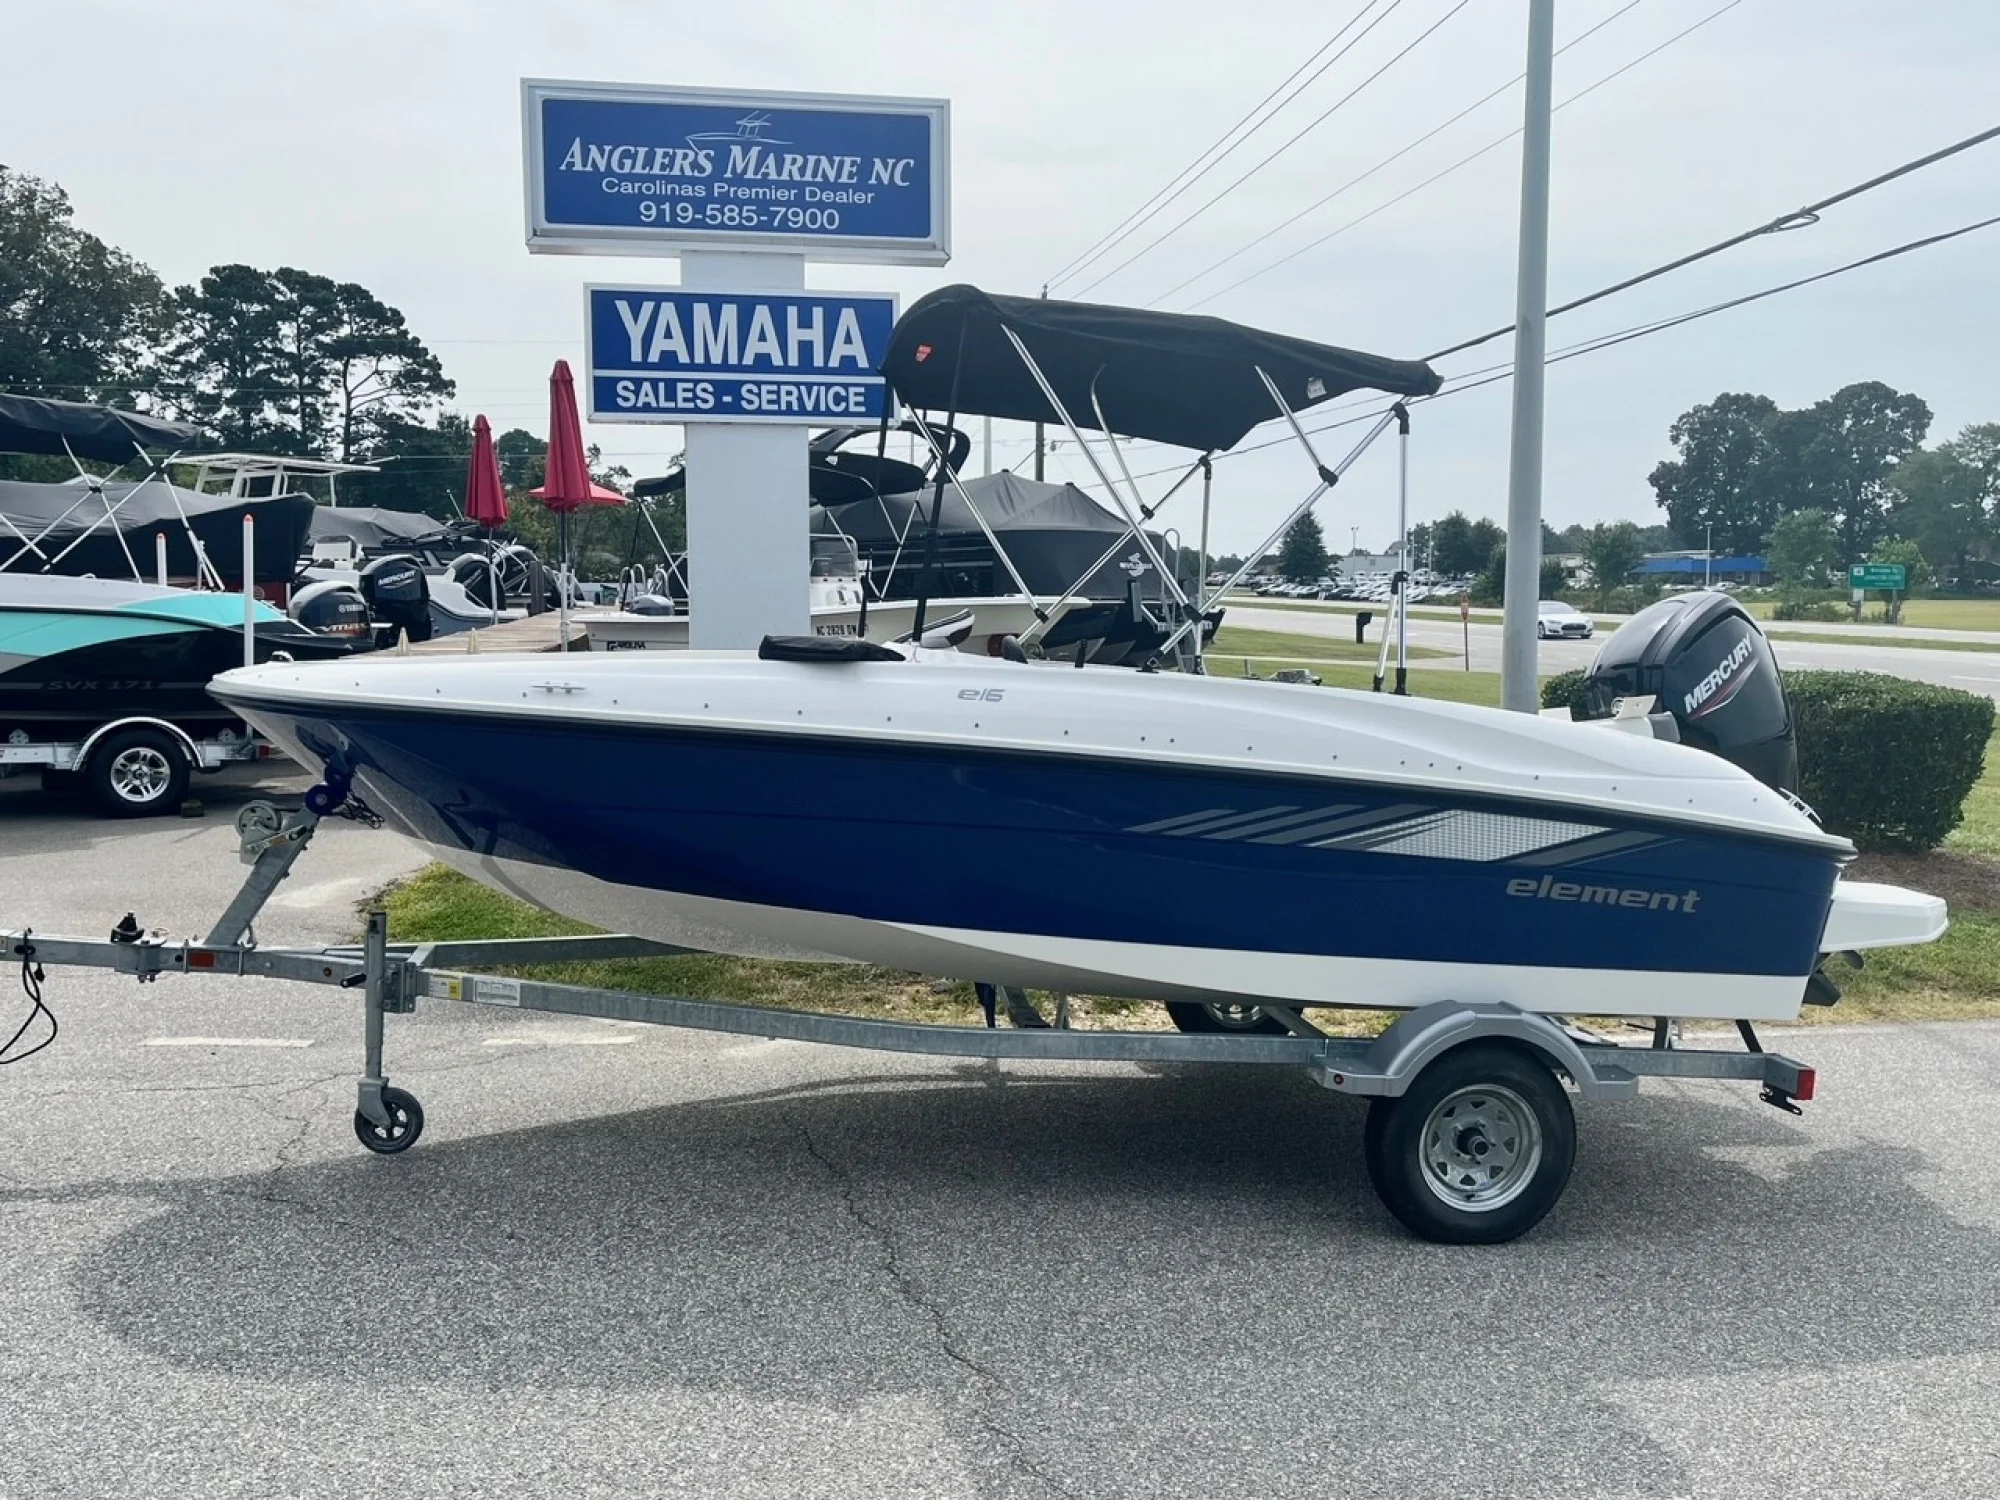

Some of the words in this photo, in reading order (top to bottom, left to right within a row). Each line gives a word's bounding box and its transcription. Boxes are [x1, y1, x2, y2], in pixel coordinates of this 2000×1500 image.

[559, 136, 715, 178] ANGLERS
[723, 144, 861, 184] MARINE
[868, 157, 915, 187] NC
[602, 177, 706, 198] Carolinas
[713, 183, 798, 201] Premier
[805, 186, 876, 204] Dealer
[639, 201, 840, 230] 919-585-7900
[614, 300, 870, 368] YAMAHA
[616, 380, 715, 410] SALES
[740, 384, 867, 413] SERVICE
[47, 680, 100, 690] SVX
[107, 680, 153, 690] 171
[1683, 631, 1753, 715] MERCURY
[1505, 874, 1701, 914] element
